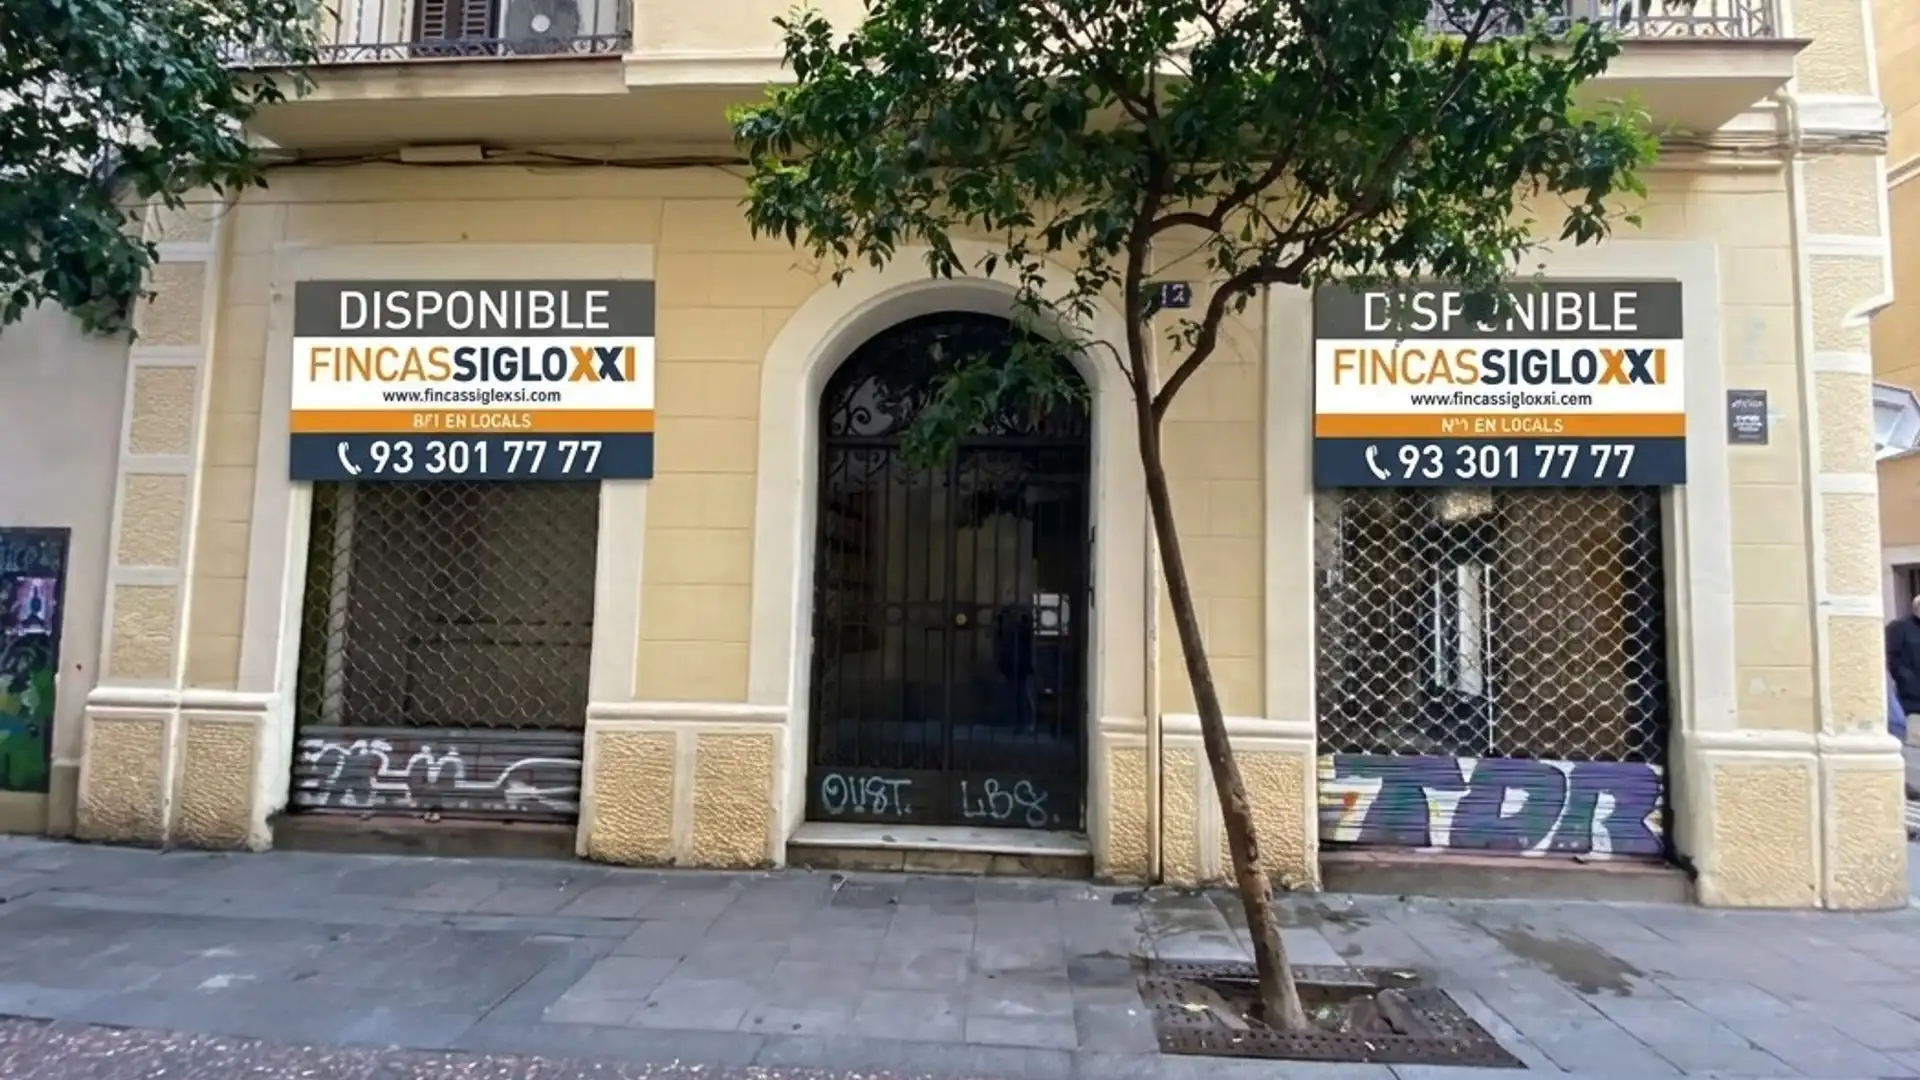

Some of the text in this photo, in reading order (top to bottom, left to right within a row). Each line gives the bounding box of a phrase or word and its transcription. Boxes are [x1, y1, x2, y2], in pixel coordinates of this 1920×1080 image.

[340, 290, 610, 330] DISPONIBLE
[310, 346, 636, 382] FINCASSIGLOXXI
[1333, 348, 1665, 386] FINCASSIGLOXXI
[471, 413, 532, 428] LOCALS
[1474, 417, 1496, 433] EN
[1501, 417, 1564, 433] LOCALS
[370, 440, 602, 474] 93 301 77 77
[1398, 444, 1635, 479] 93 301 77 77
